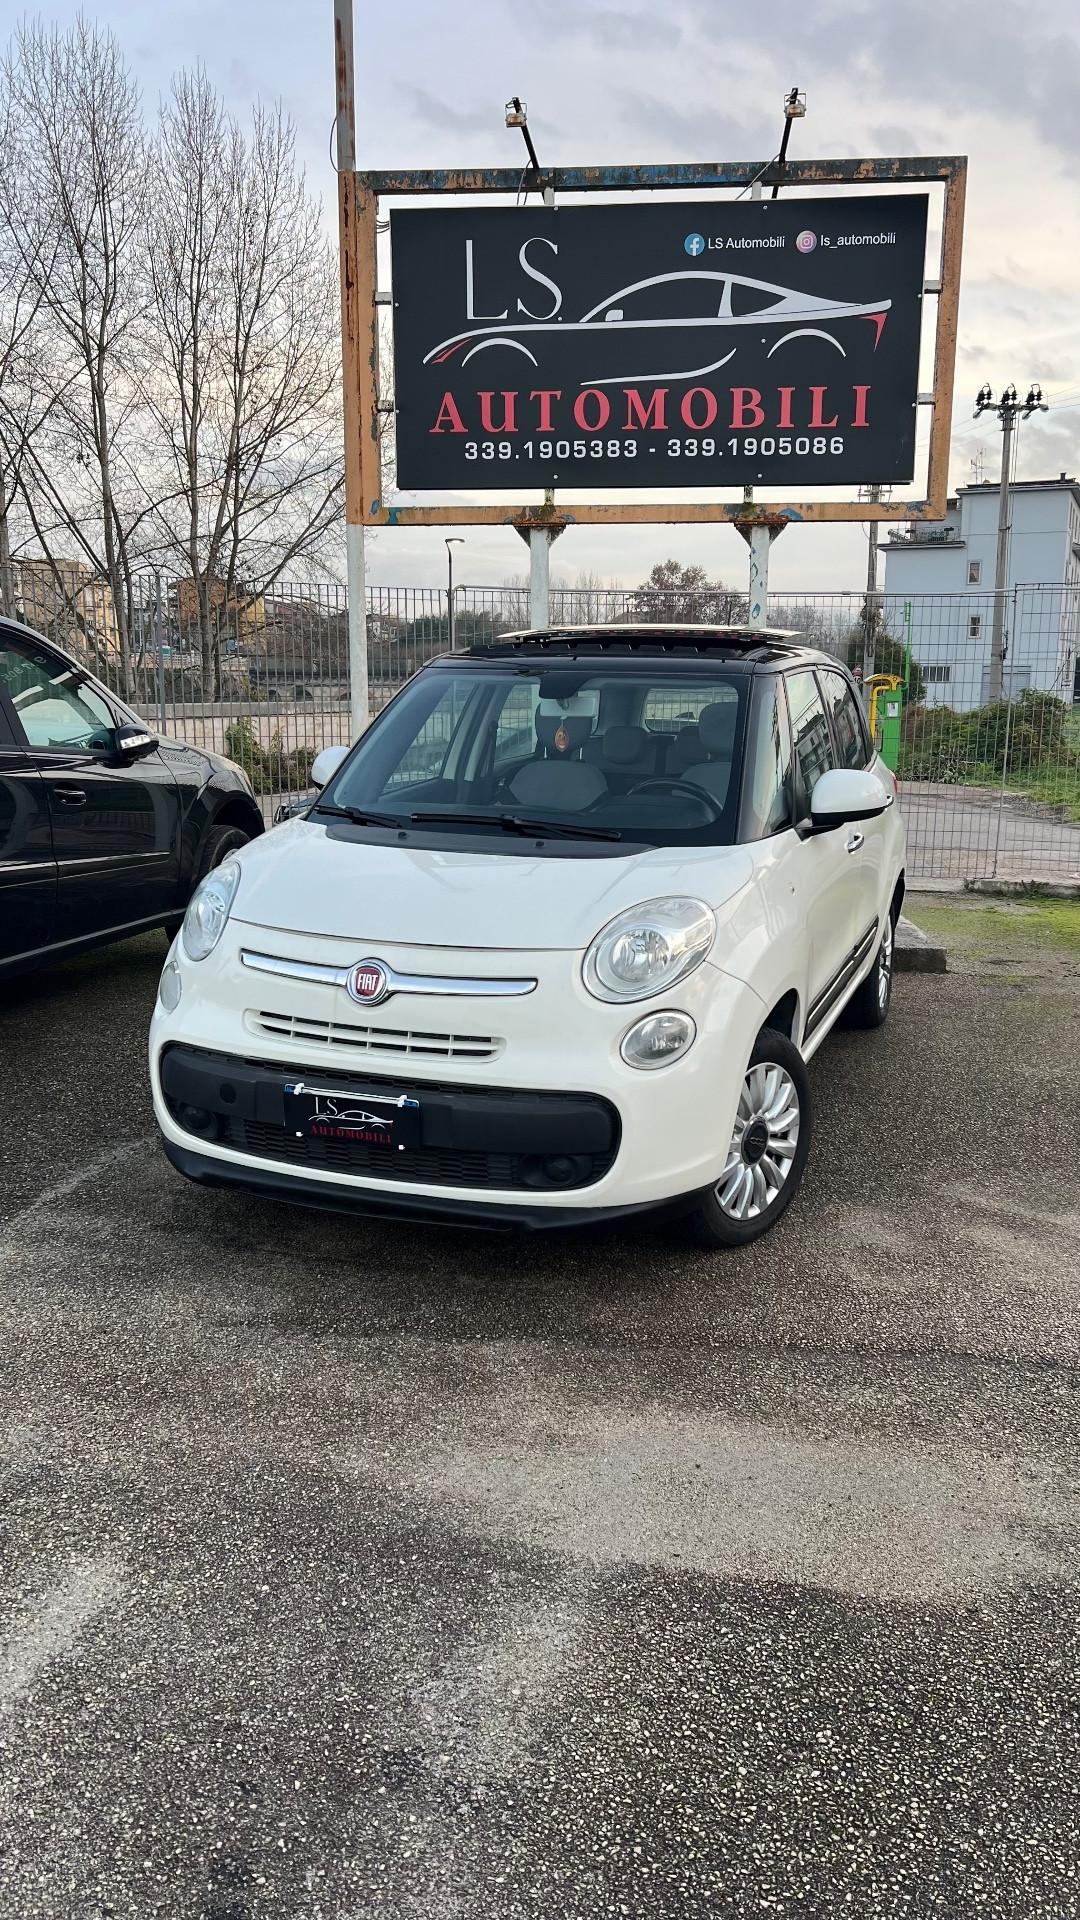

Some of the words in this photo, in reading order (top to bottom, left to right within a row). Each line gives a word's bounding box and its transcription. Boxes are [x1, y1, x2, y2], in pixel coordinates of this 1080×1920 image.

[708, 237, 724, 249] LS
[725, 235, 785, 250] Automobili
[820, 232, 896, 249] ls_automobili
[428, 385, 872, 433] AUTOMOBILI
[464, 438, 639, 460] 339.1905383
[666, 436, 845, 457] 339.1905086
[357, 973, 379, 991] FIAT
[311, 1124, 393, 1143] AUTOMOBILI
